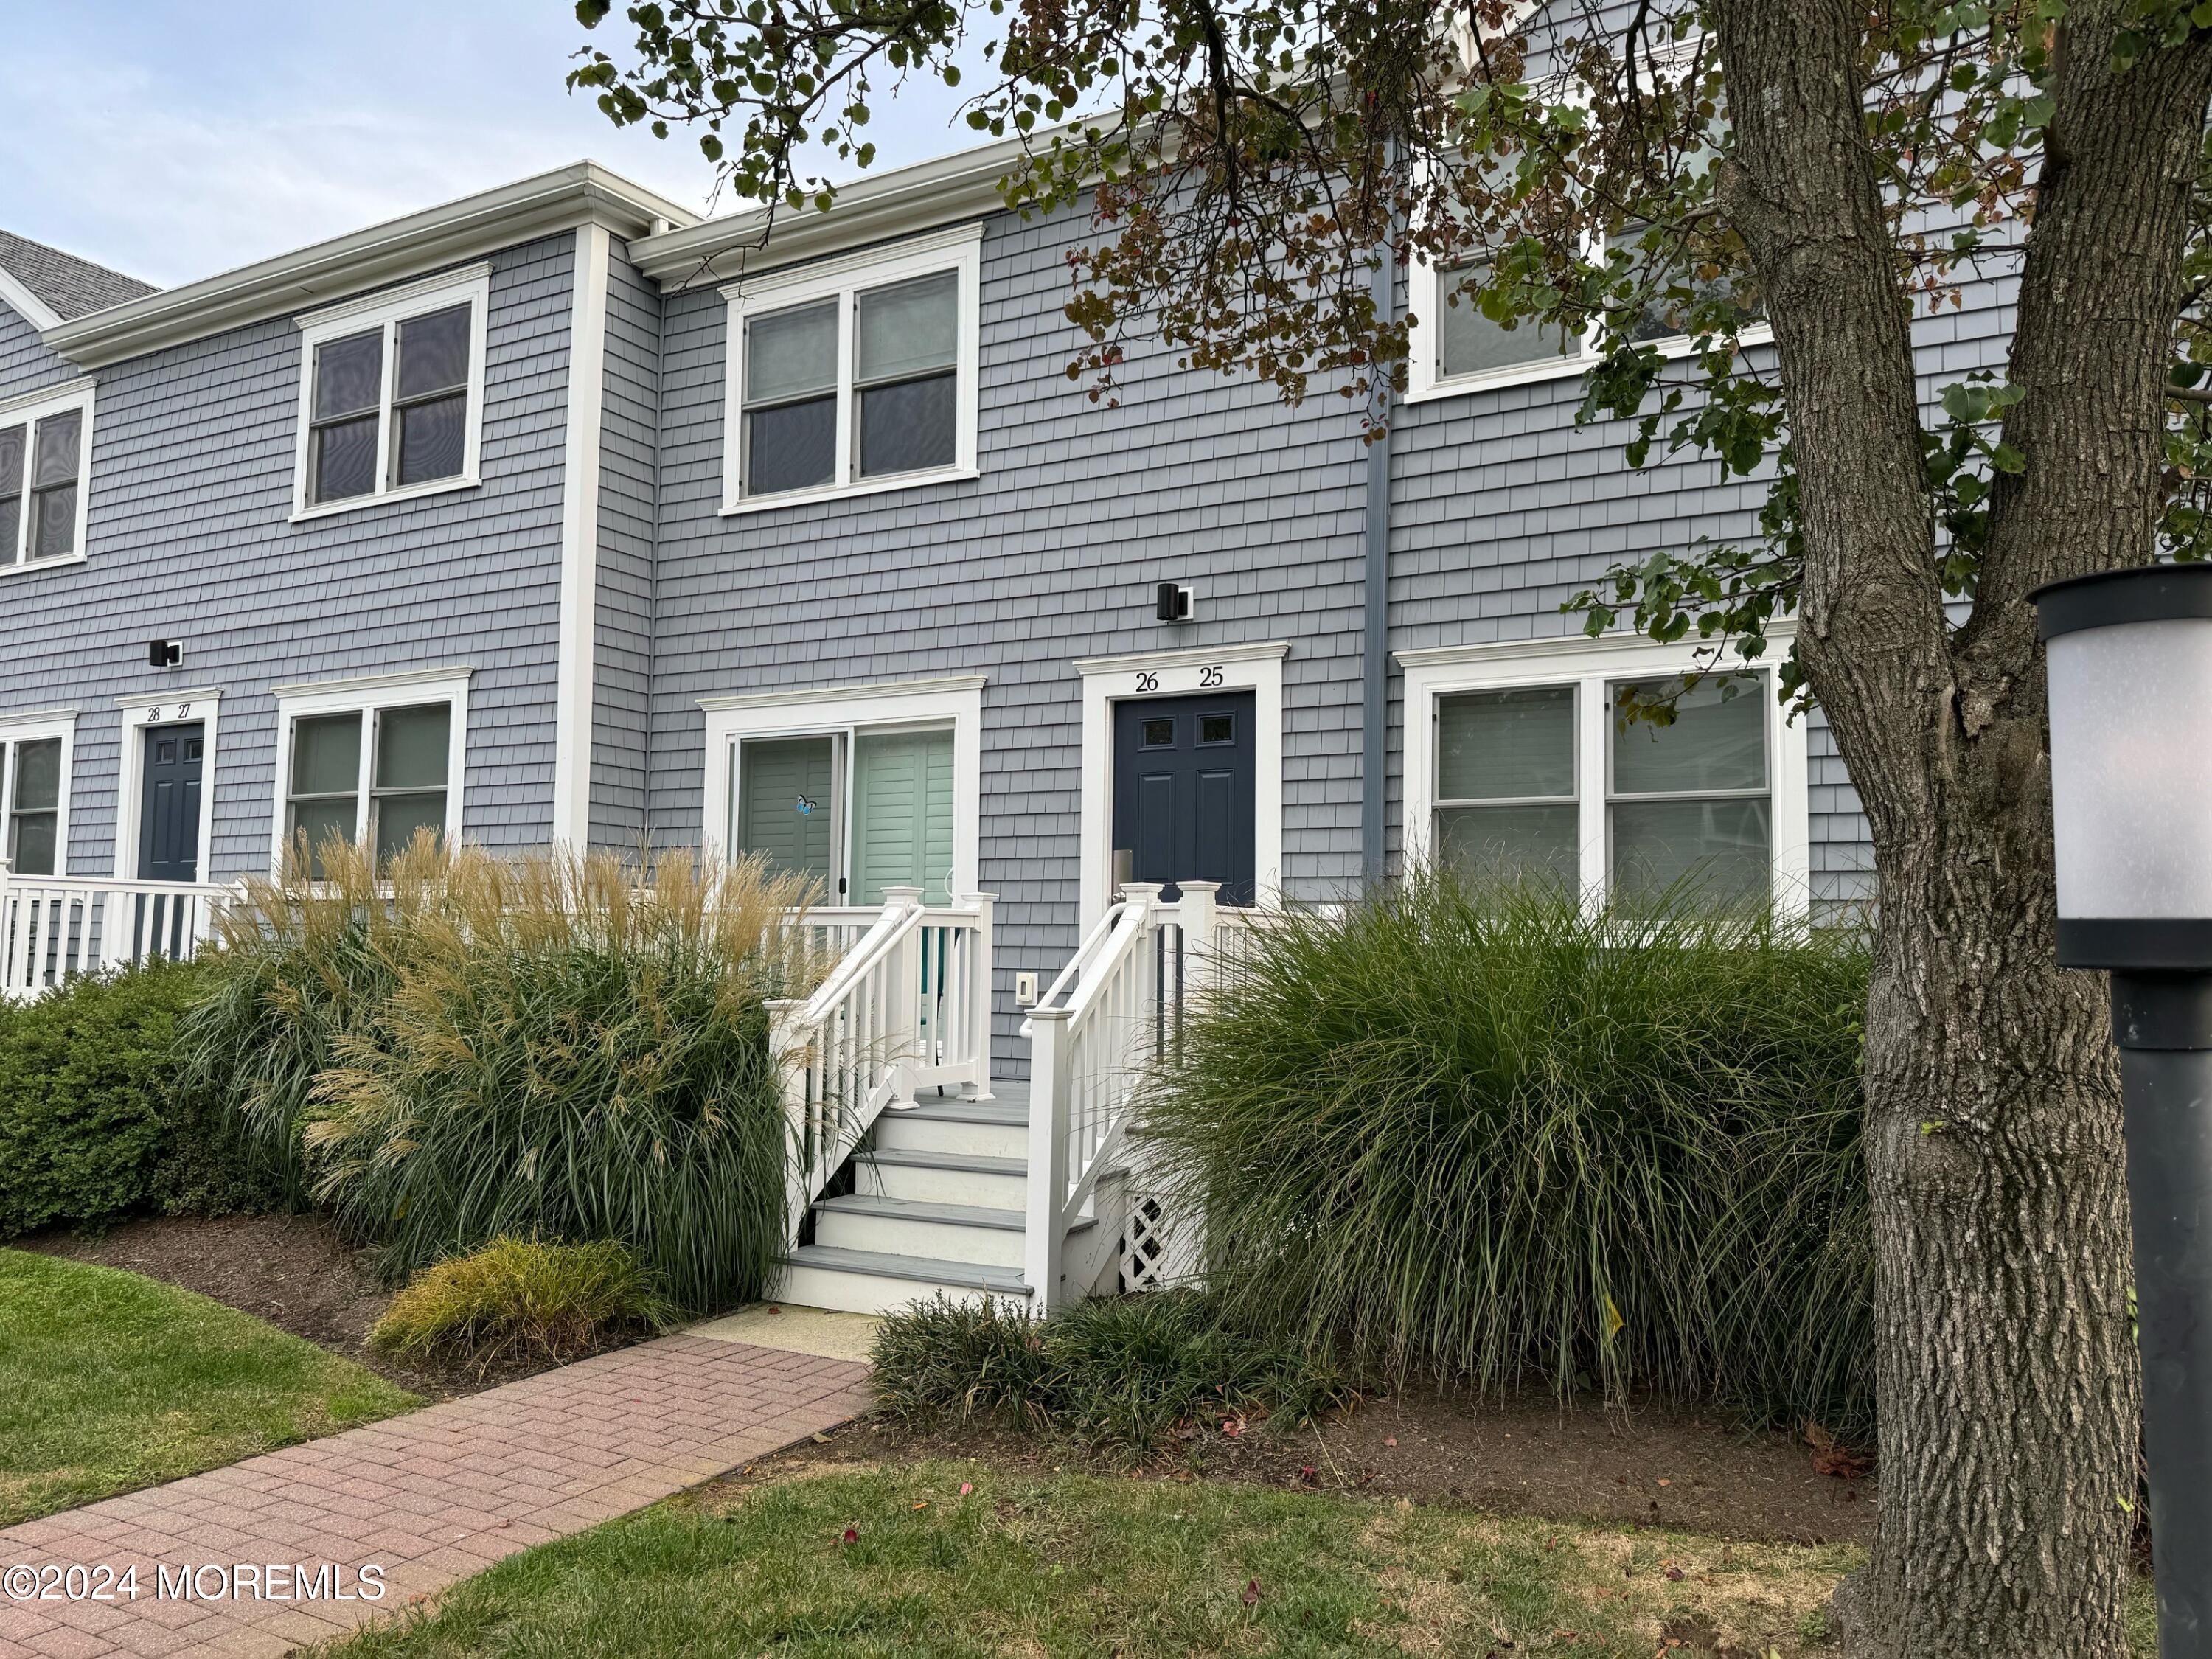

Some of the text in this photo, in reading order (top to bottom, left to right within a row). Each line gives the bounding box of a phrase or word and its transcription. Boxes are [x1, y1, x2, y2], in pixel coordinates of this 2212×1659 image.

[1135, 665, 1224, 692] 26 25
[147, 703, 191, 722] 28 27
